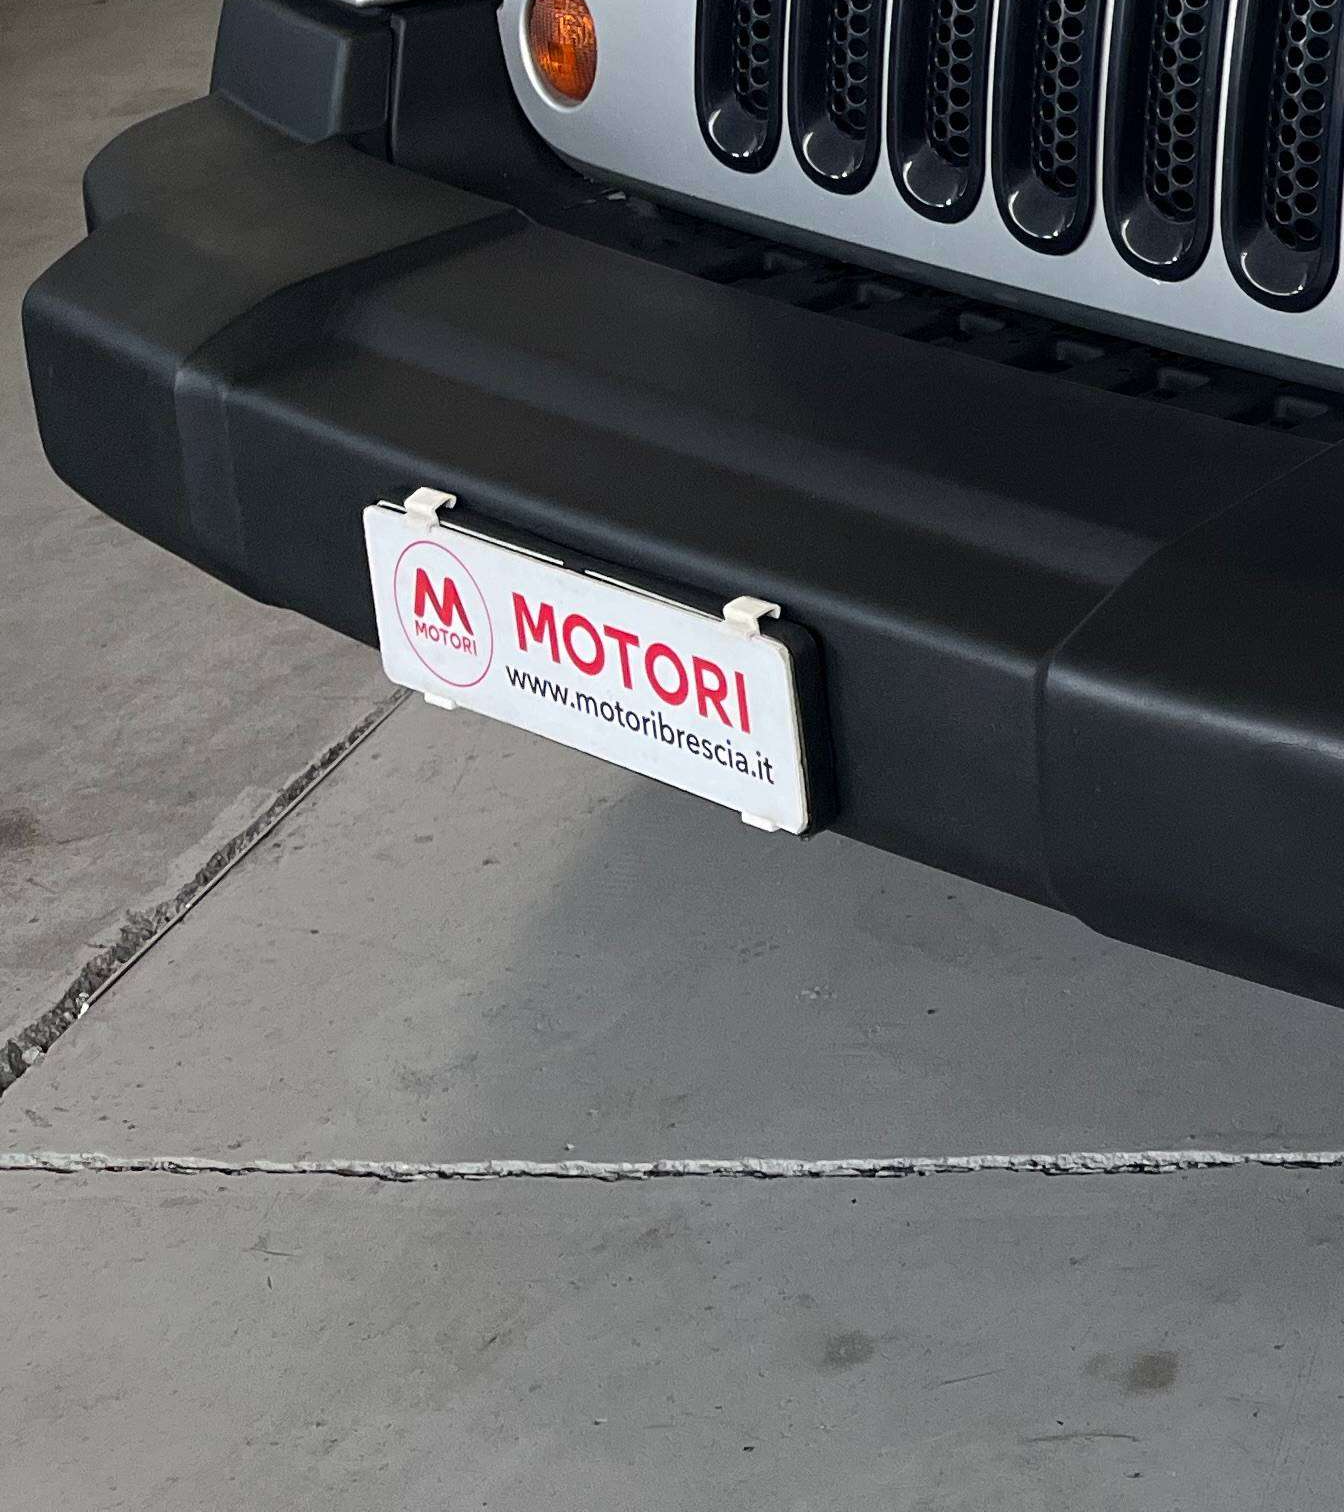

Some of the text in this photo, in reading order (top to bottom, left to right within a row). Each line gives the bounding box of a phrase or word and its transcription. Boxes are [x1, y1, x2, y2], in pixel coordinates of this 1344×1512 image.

[413, 567, 474, 636] M
[415, 619, 478, 657] MOTORI
[512, 591, 751, 734] MOTORI
[506, 664, 775, 785] www.motoribrescia.it
